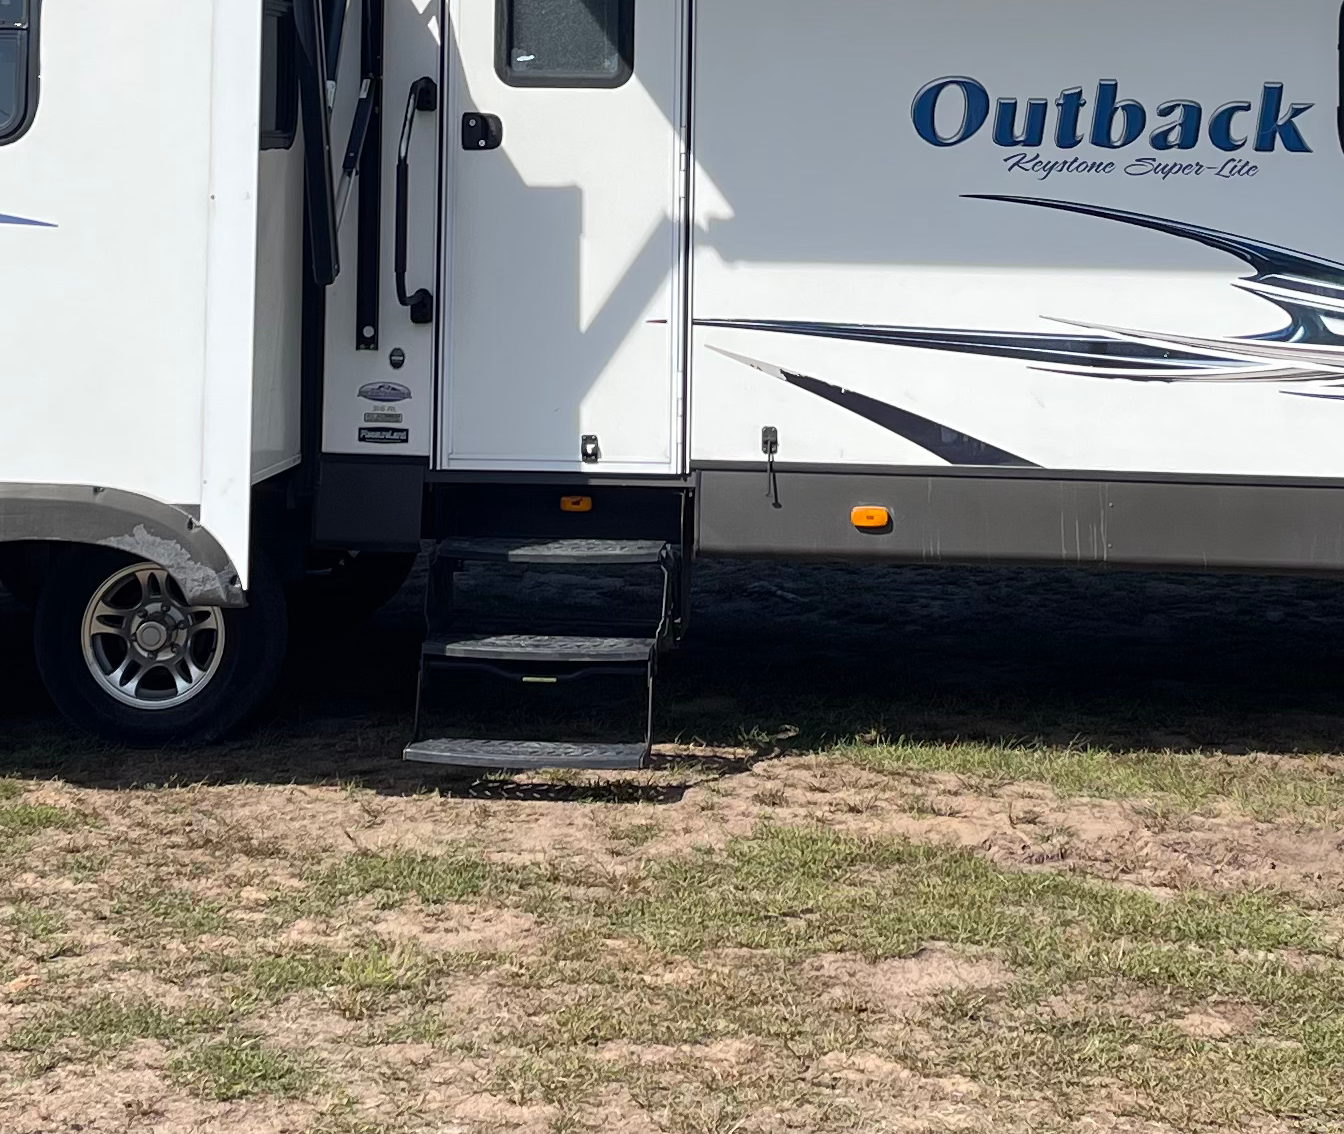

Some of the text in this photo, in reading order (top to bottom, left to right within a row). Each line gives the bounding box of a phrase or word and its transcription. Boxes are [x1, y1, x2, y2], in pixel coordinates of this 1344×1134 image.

[911, 75, 1315, 153] Outback
[1002, 152, 1260, 181] Keystone Super-Lite
